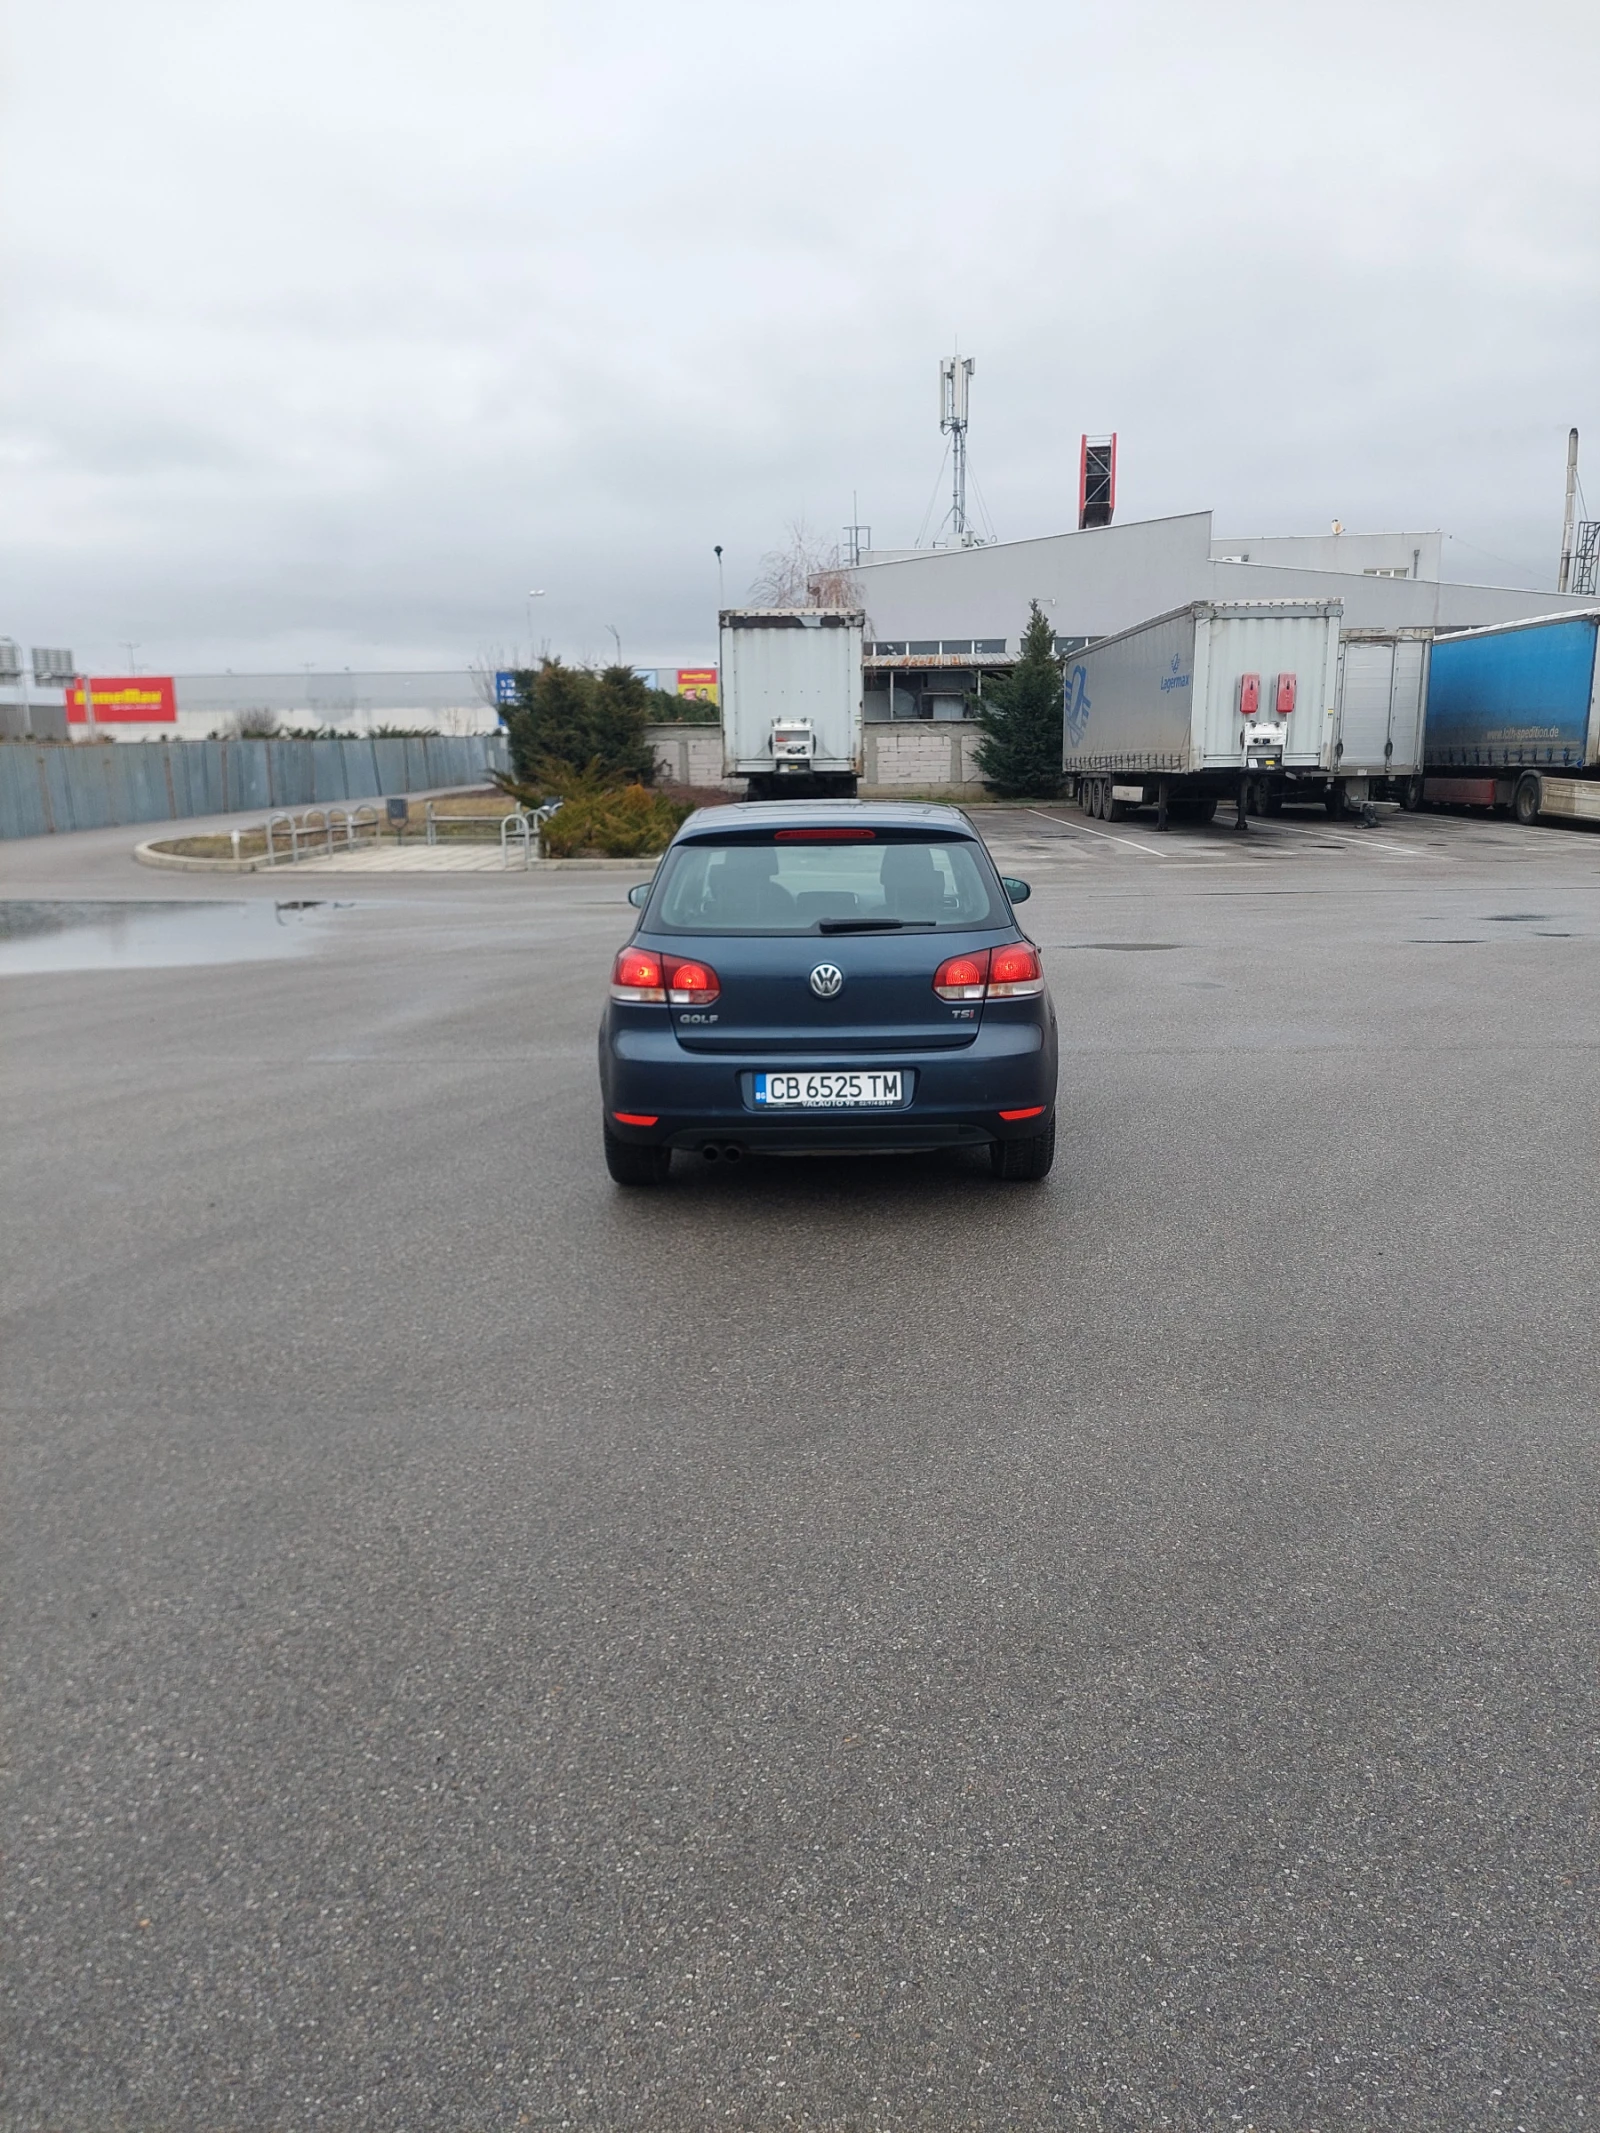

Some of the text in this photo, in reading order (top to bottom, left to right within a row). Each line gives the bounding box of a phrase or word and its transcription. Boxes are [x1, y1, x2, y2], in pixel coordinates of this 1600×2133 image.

[1160, 674, 1190, 694] Lagermax
[680, 1014, 719, 1024] GOLF
[770, 1074, 898, 1099] CB 6525 TM
